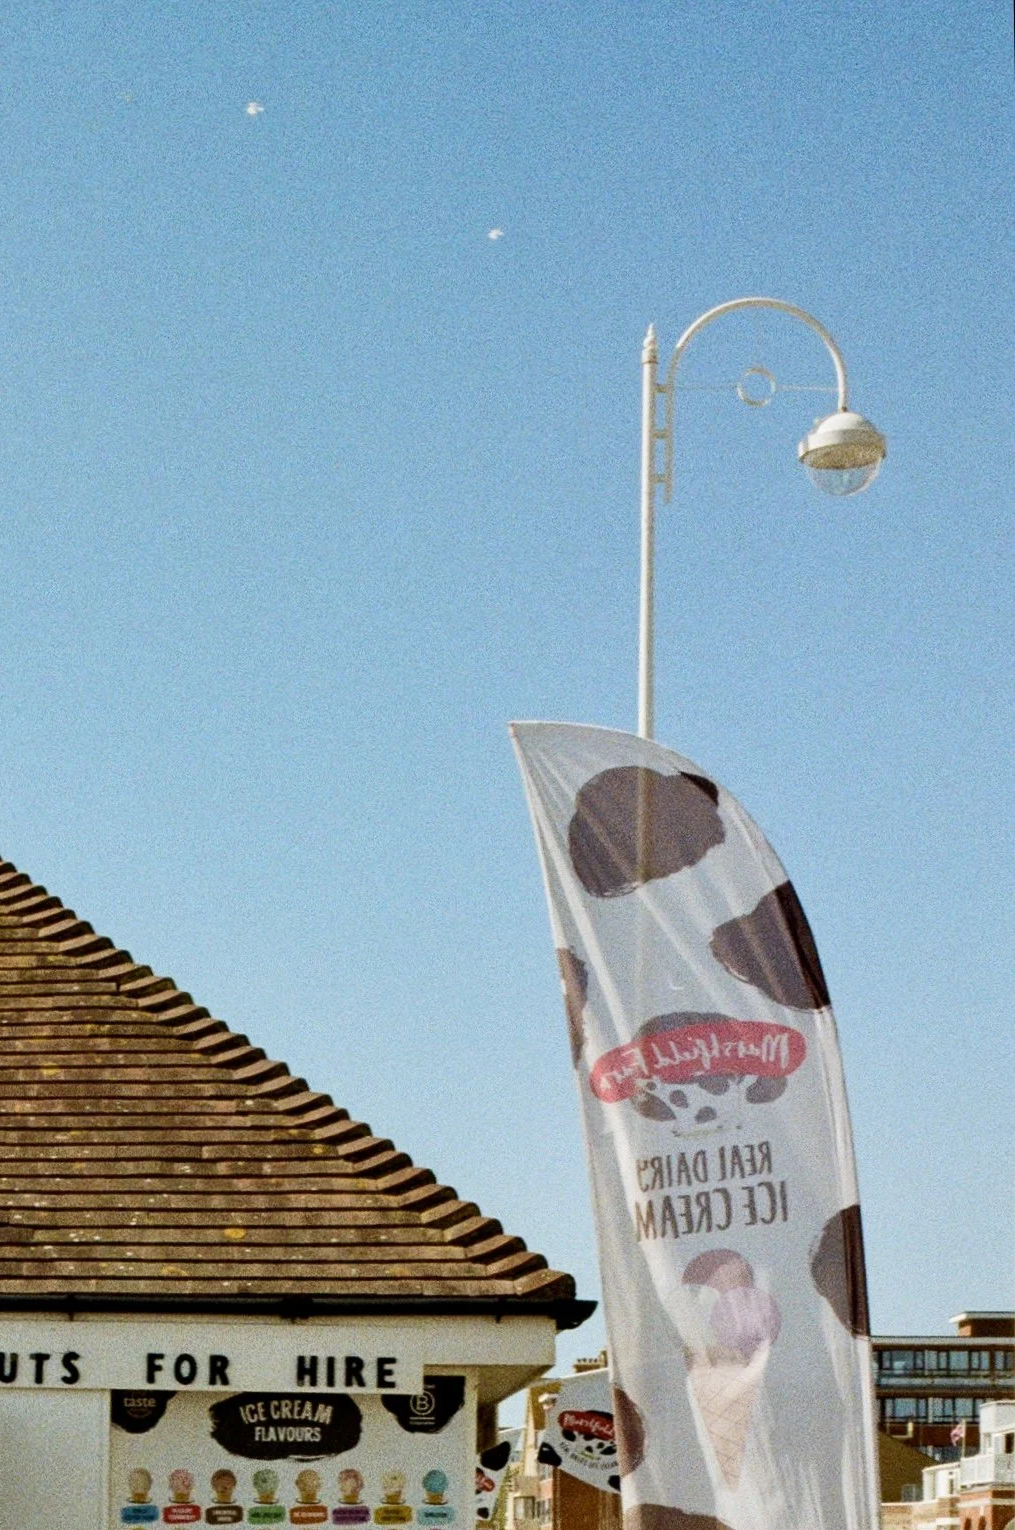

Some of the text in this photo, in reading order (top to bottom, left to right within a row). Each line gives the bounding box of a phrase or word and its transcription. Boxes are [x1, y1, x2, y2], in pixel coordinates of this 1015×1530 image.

[146, 1353, 231, 1386] FOR
[295, 1356, 397, 1389] HIRE
[239, 1400, 333, 1424] ICE CREAM
[254, 1426, 321, 1442] FLAVOURS
